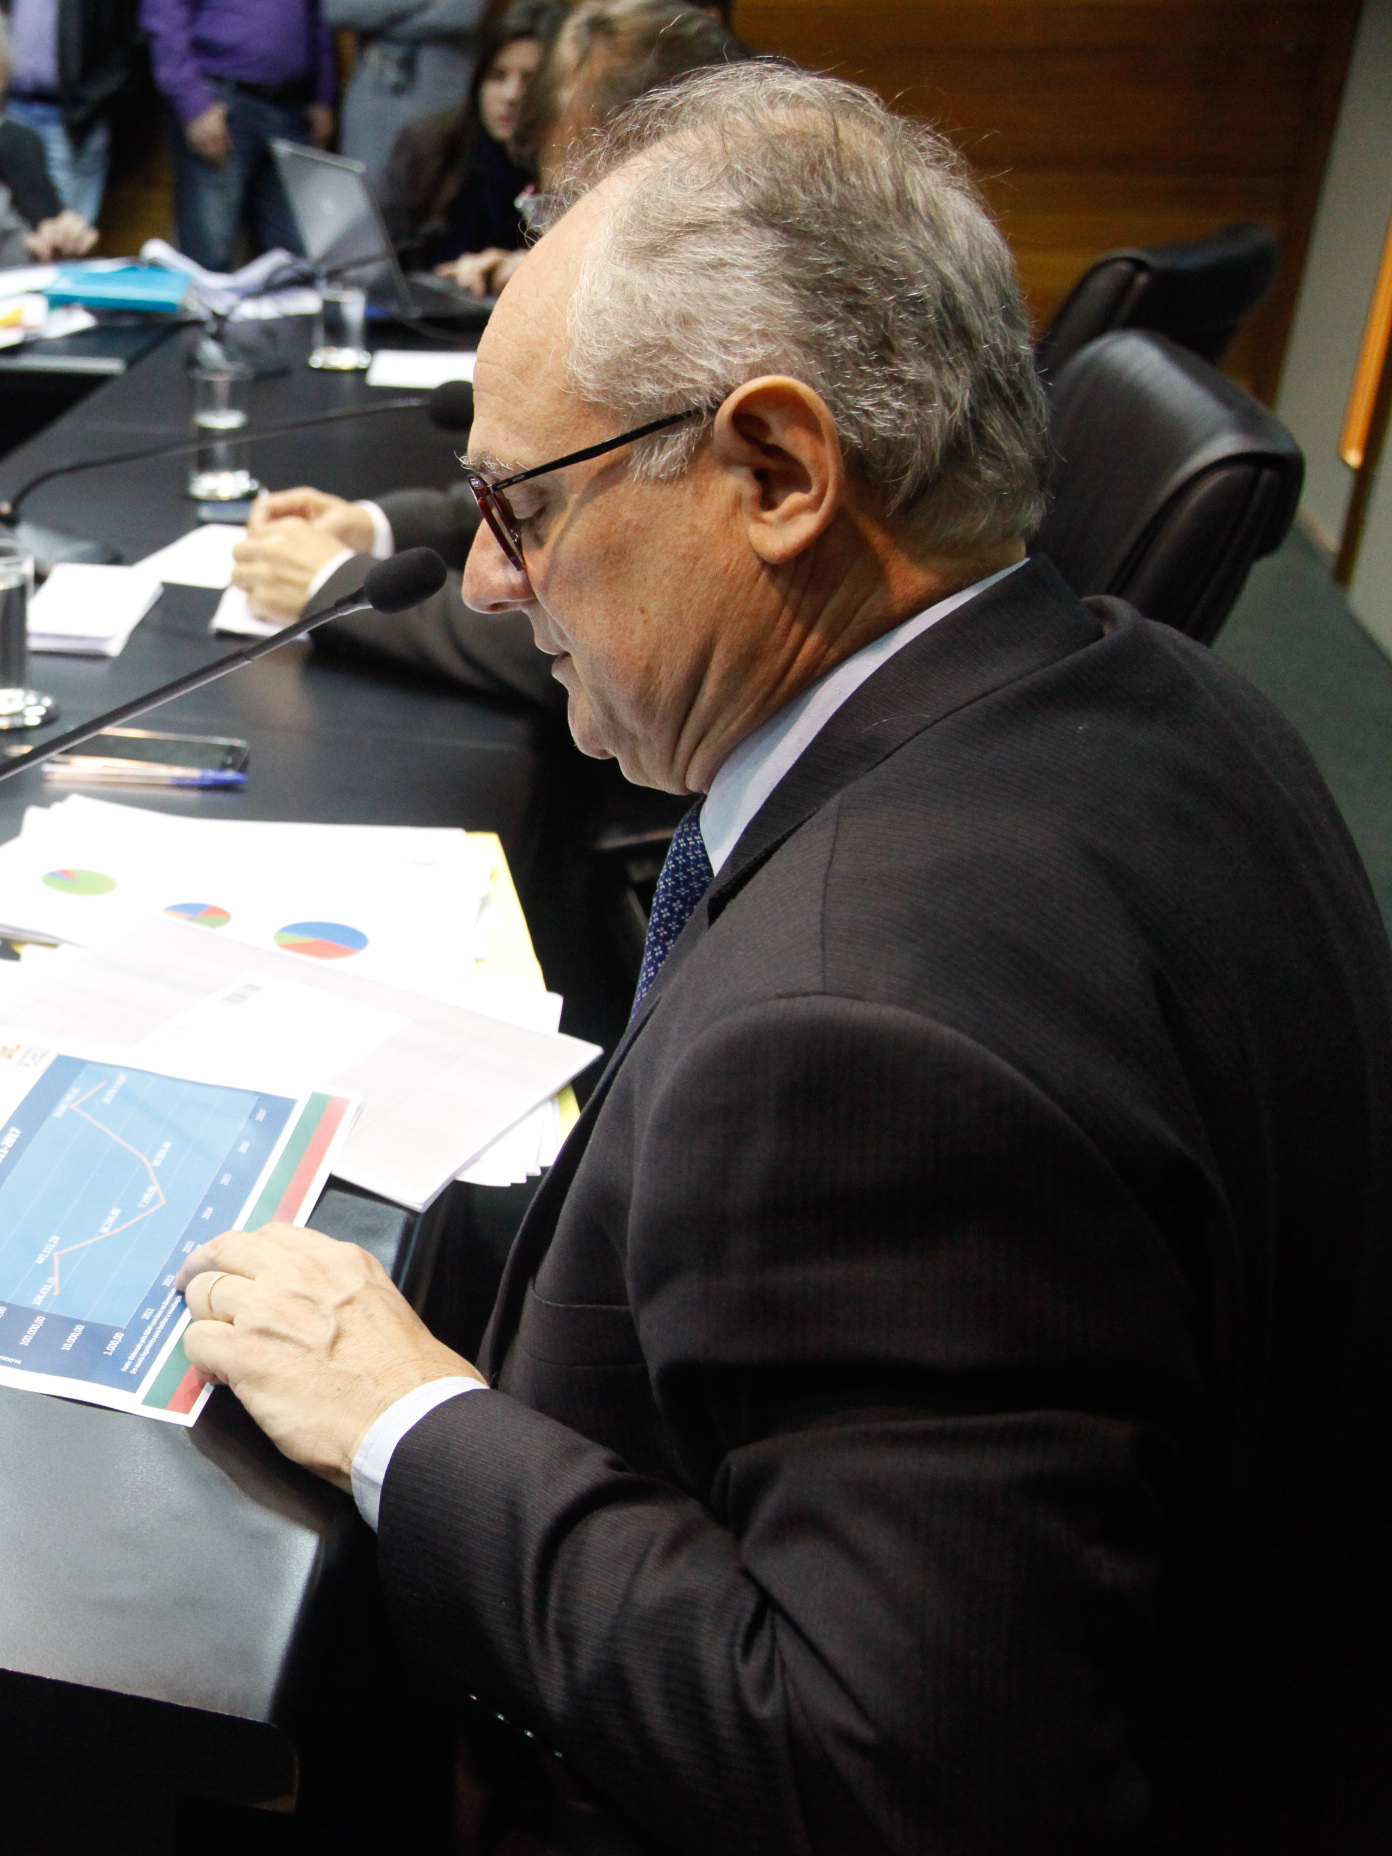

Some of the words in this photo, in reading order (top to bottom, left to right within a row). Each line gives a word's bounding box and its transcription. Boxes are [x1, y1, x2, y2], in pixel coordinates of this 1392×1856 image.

[19, 1315, 46, 1345] 100.000,00
[61, 1324, 87, 1351] 10.000,00
[103, 1332, 125, 1355] 1.000,00
